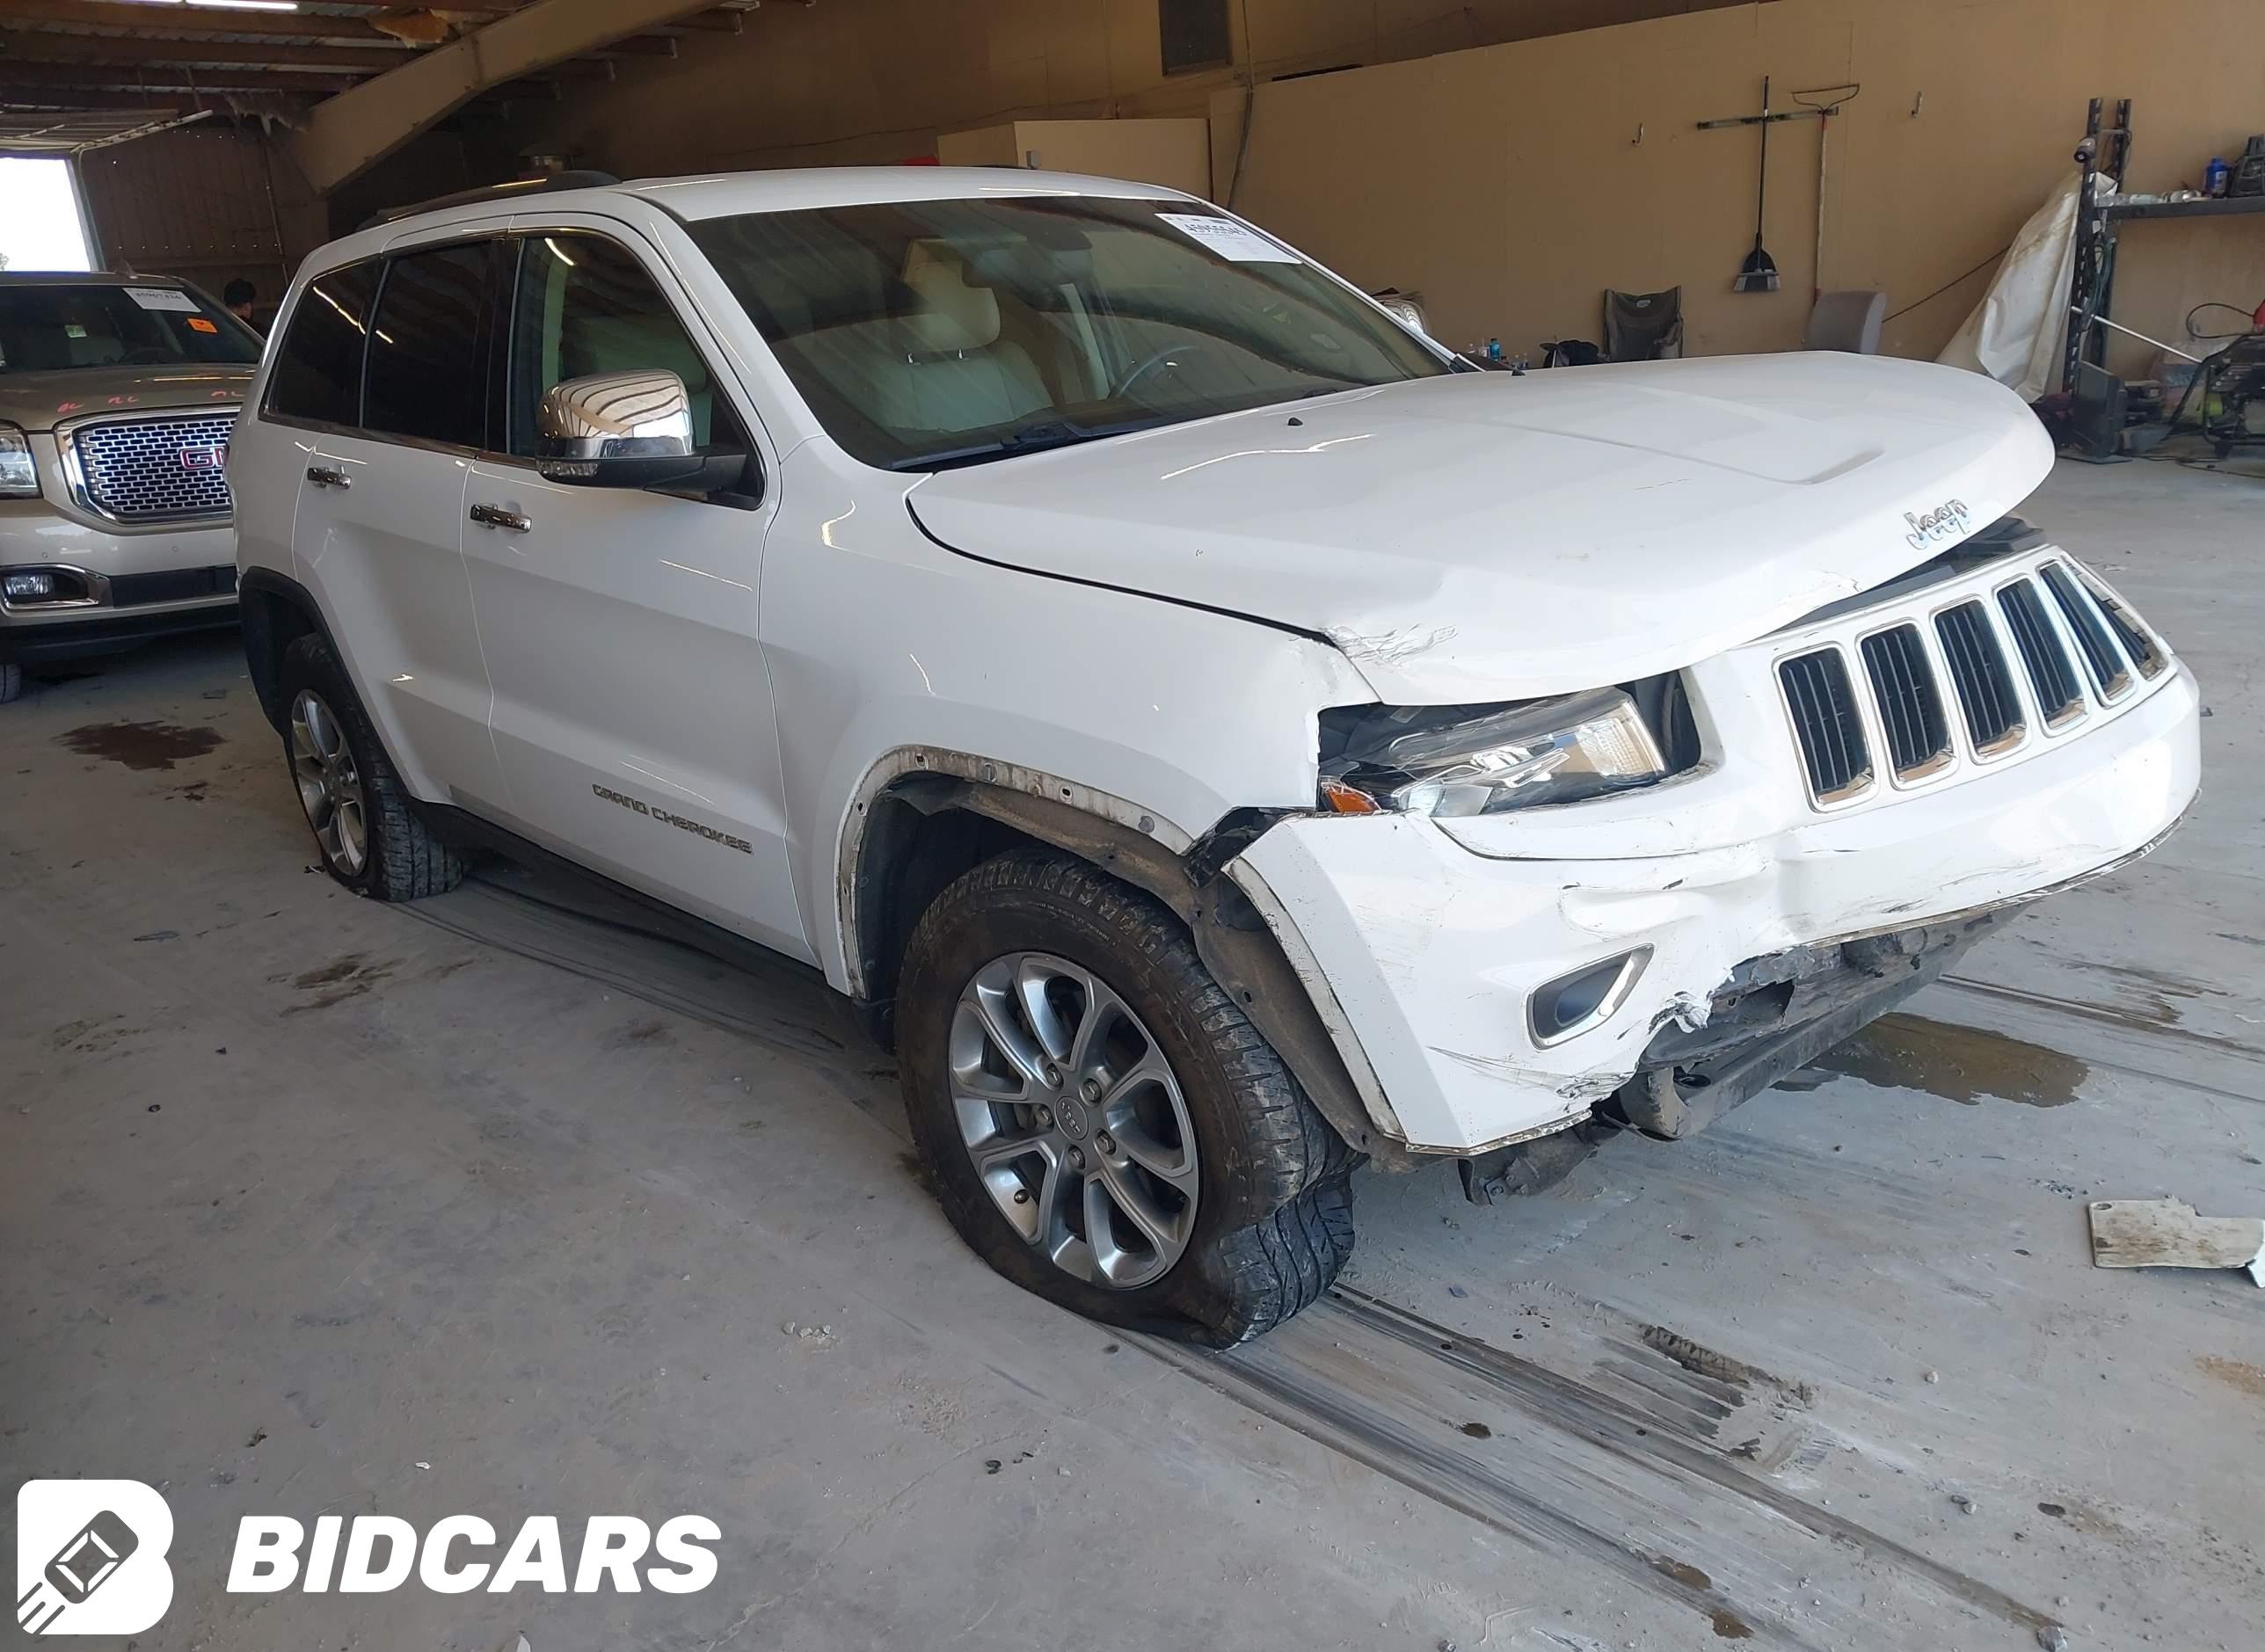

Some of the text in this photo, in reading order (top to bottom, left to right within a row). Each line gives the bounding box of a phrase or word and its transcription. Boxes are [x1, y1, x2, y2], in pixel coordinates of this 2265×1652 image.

[1903, 499, 1970, 550] Jeep
[592, 783, 754, 855] GRAND CHEROKEE
